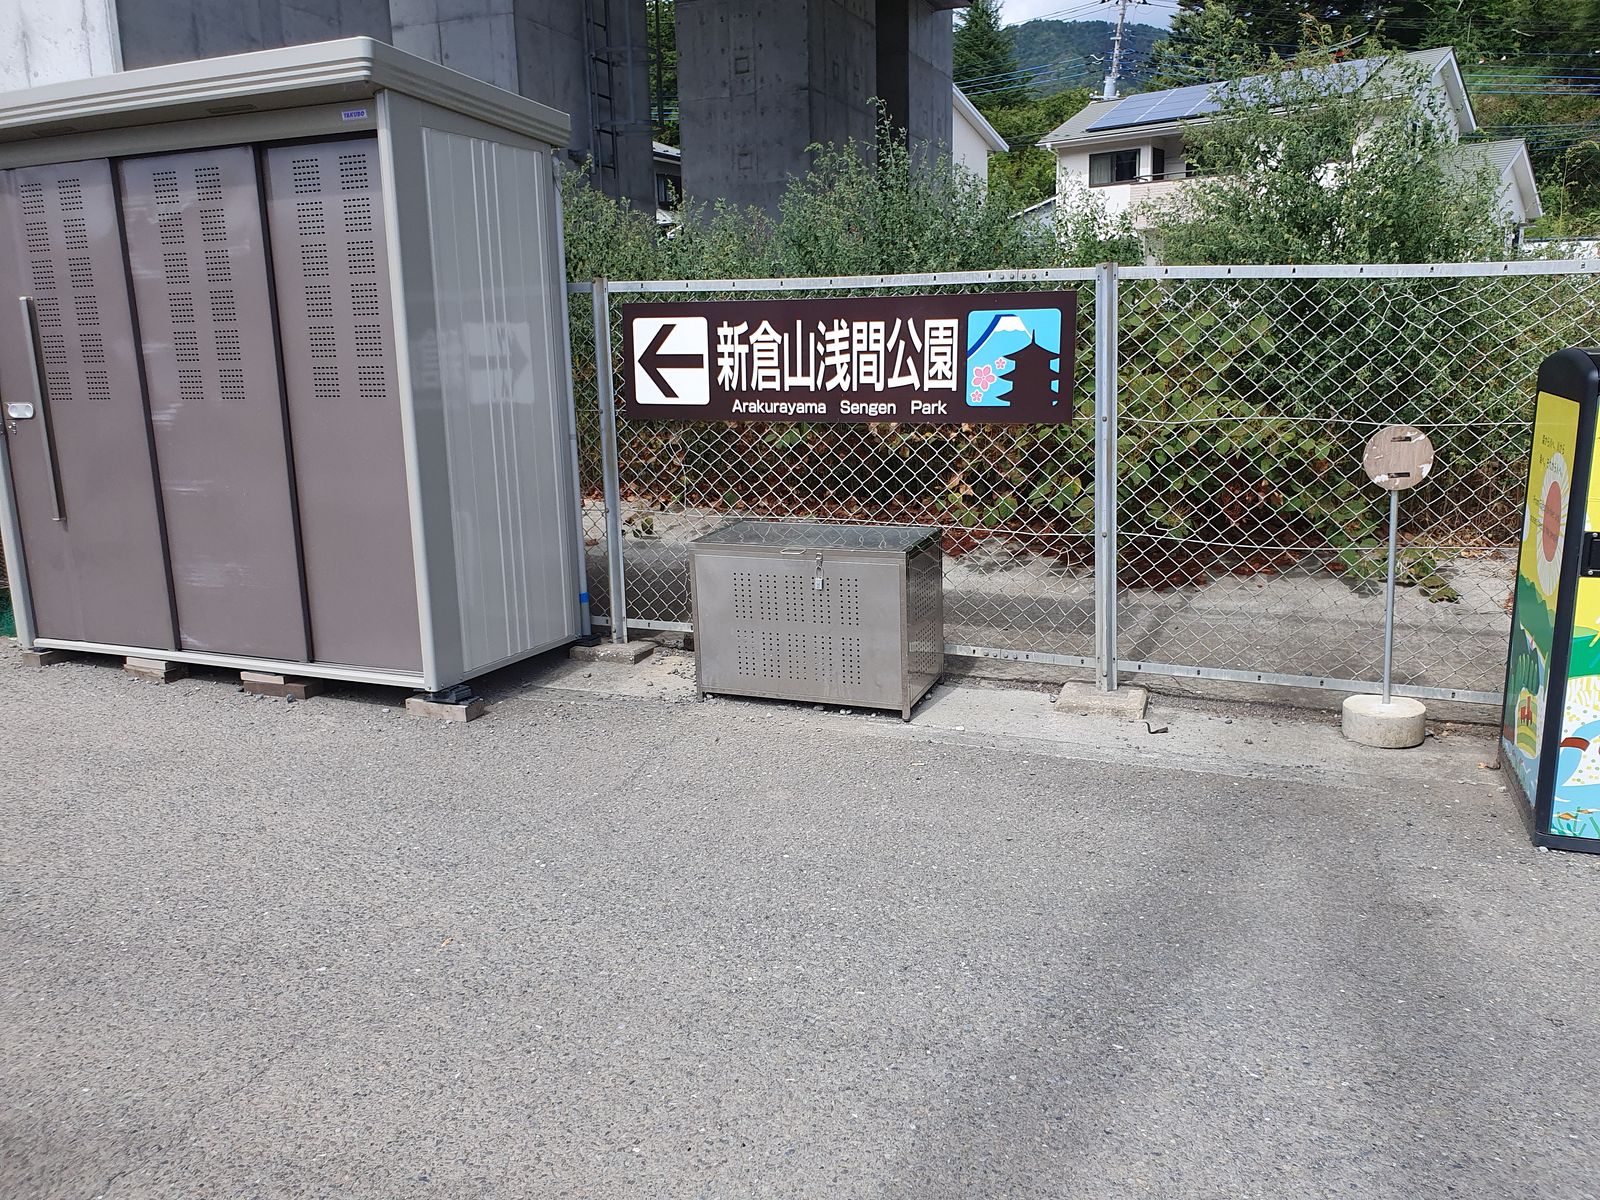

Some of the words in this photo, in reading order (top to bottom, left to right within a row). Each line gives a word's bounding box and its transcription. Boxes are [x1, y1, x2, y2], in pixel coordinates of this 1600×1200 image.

[716, 317, 959, 392] 新倉山浅間公園
[732, 399, 827, 416] Arakurayama
[840, 400, 897, 417] Sengen
[911, 400, 948, 415] Park
